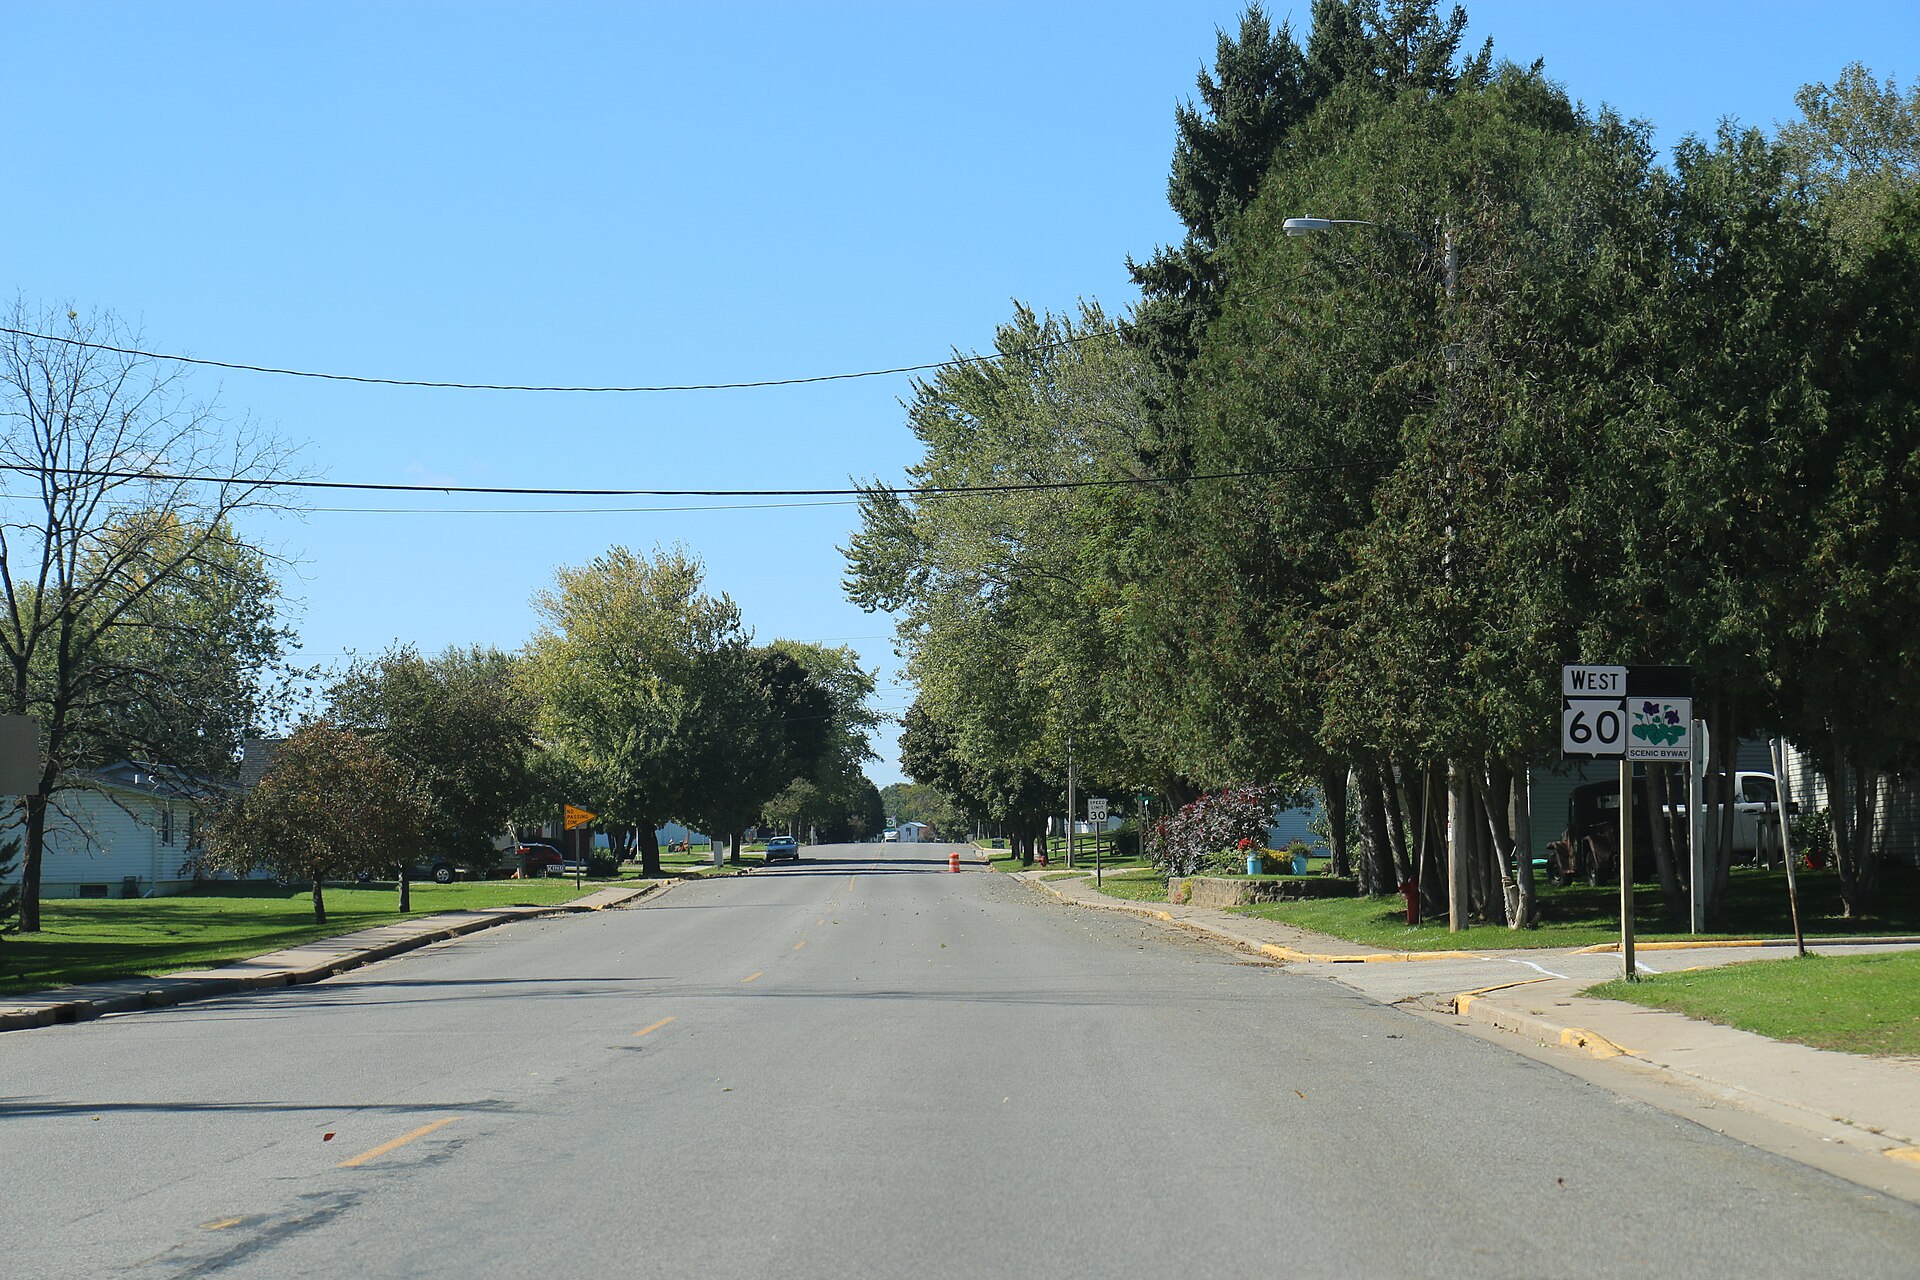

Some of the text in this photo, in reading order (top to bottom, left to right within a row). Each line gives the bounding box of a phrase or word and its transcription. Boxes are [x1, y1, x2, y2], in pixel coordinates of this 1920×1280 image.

[1571, 670, 1619, 690] WEST
[1570, 710, 1620, 744] 60
[1630, 749, 1688, 757] SCENIC BYWAY
[1090, 811, 1106, 820] 30
